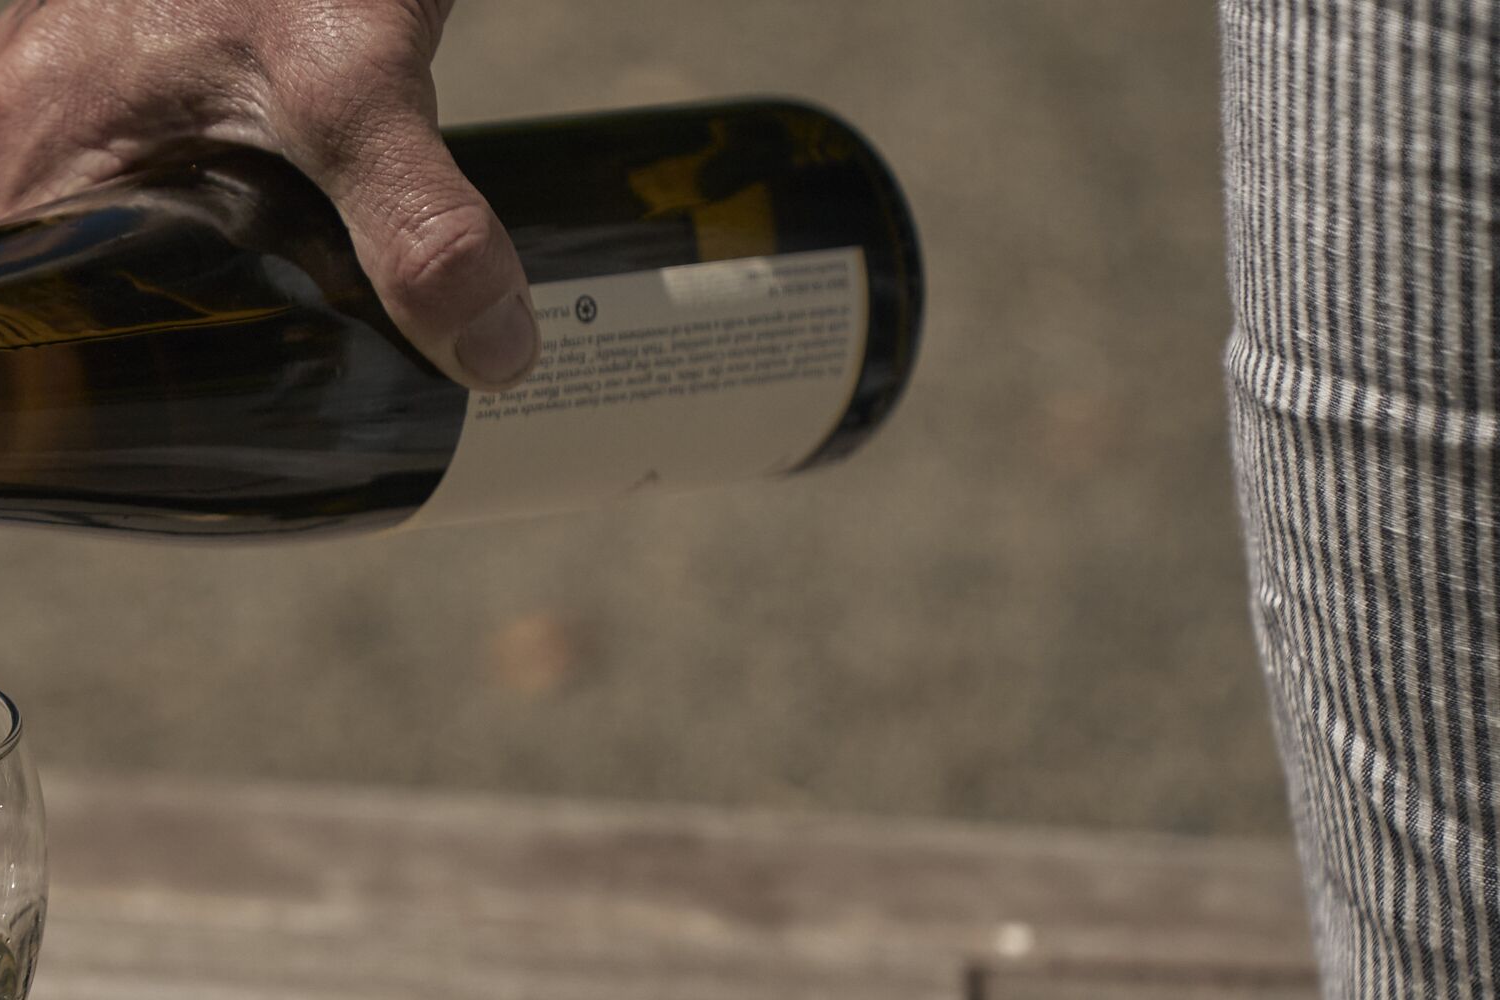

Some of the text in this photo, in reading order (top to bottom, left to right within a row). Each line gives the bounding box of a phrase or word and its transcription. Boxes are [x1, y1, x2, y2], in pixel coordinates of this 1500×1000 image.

[533, 305, 570, 320] PLEAS
[559, 334, 586, 351] crisp
[557, 350, 586, 367] Enjoy
[524, 373, 554, 386] harm
[497, 388, 528, 405] along
[531, 387, 560, 401] Blanc
[562, 382, 601, 397] Chenin
[520, 397, 572, 416] vineyards
